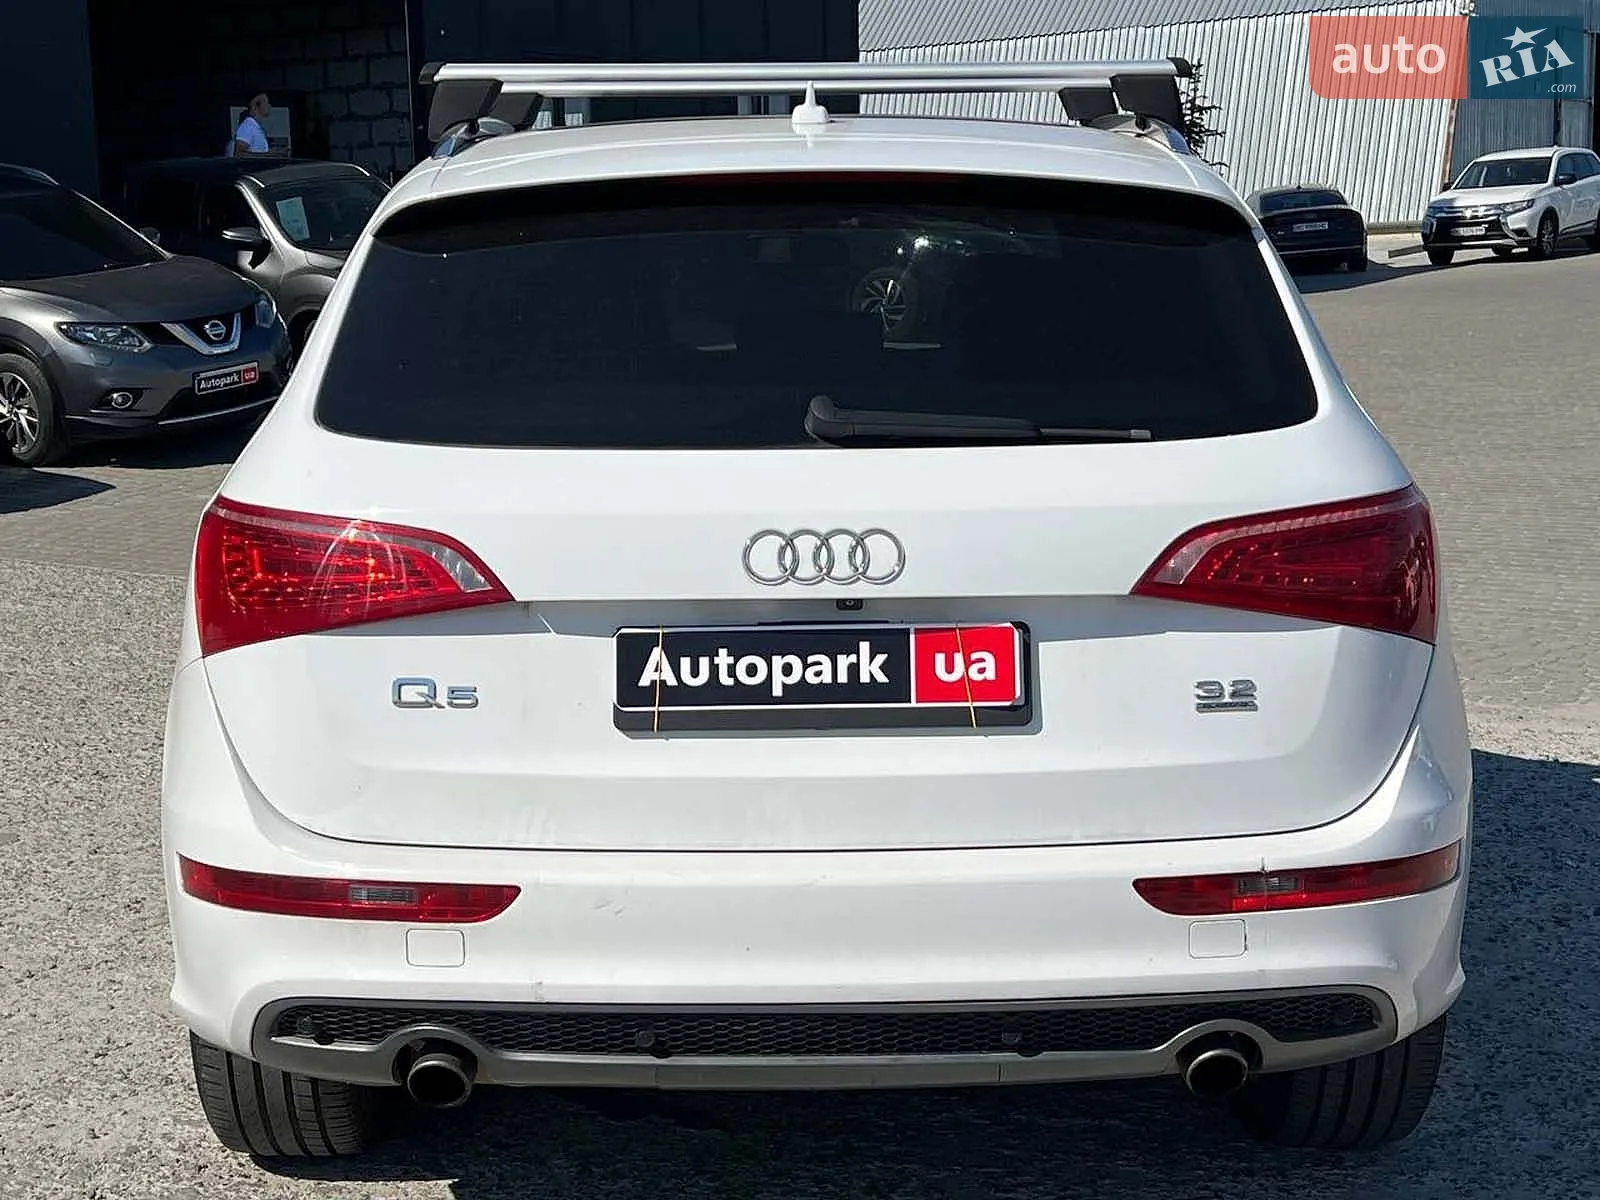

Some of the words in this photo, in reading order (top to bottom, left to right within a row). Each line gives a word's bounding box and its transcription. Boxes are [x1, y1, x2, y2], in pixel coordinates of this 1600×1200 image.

[200, 372, 240, 390] Autopark
[637, 641, 890, 697] Autopark
[934, 649, 997, 683] ua
[391, 677, 479, 709] Q5
